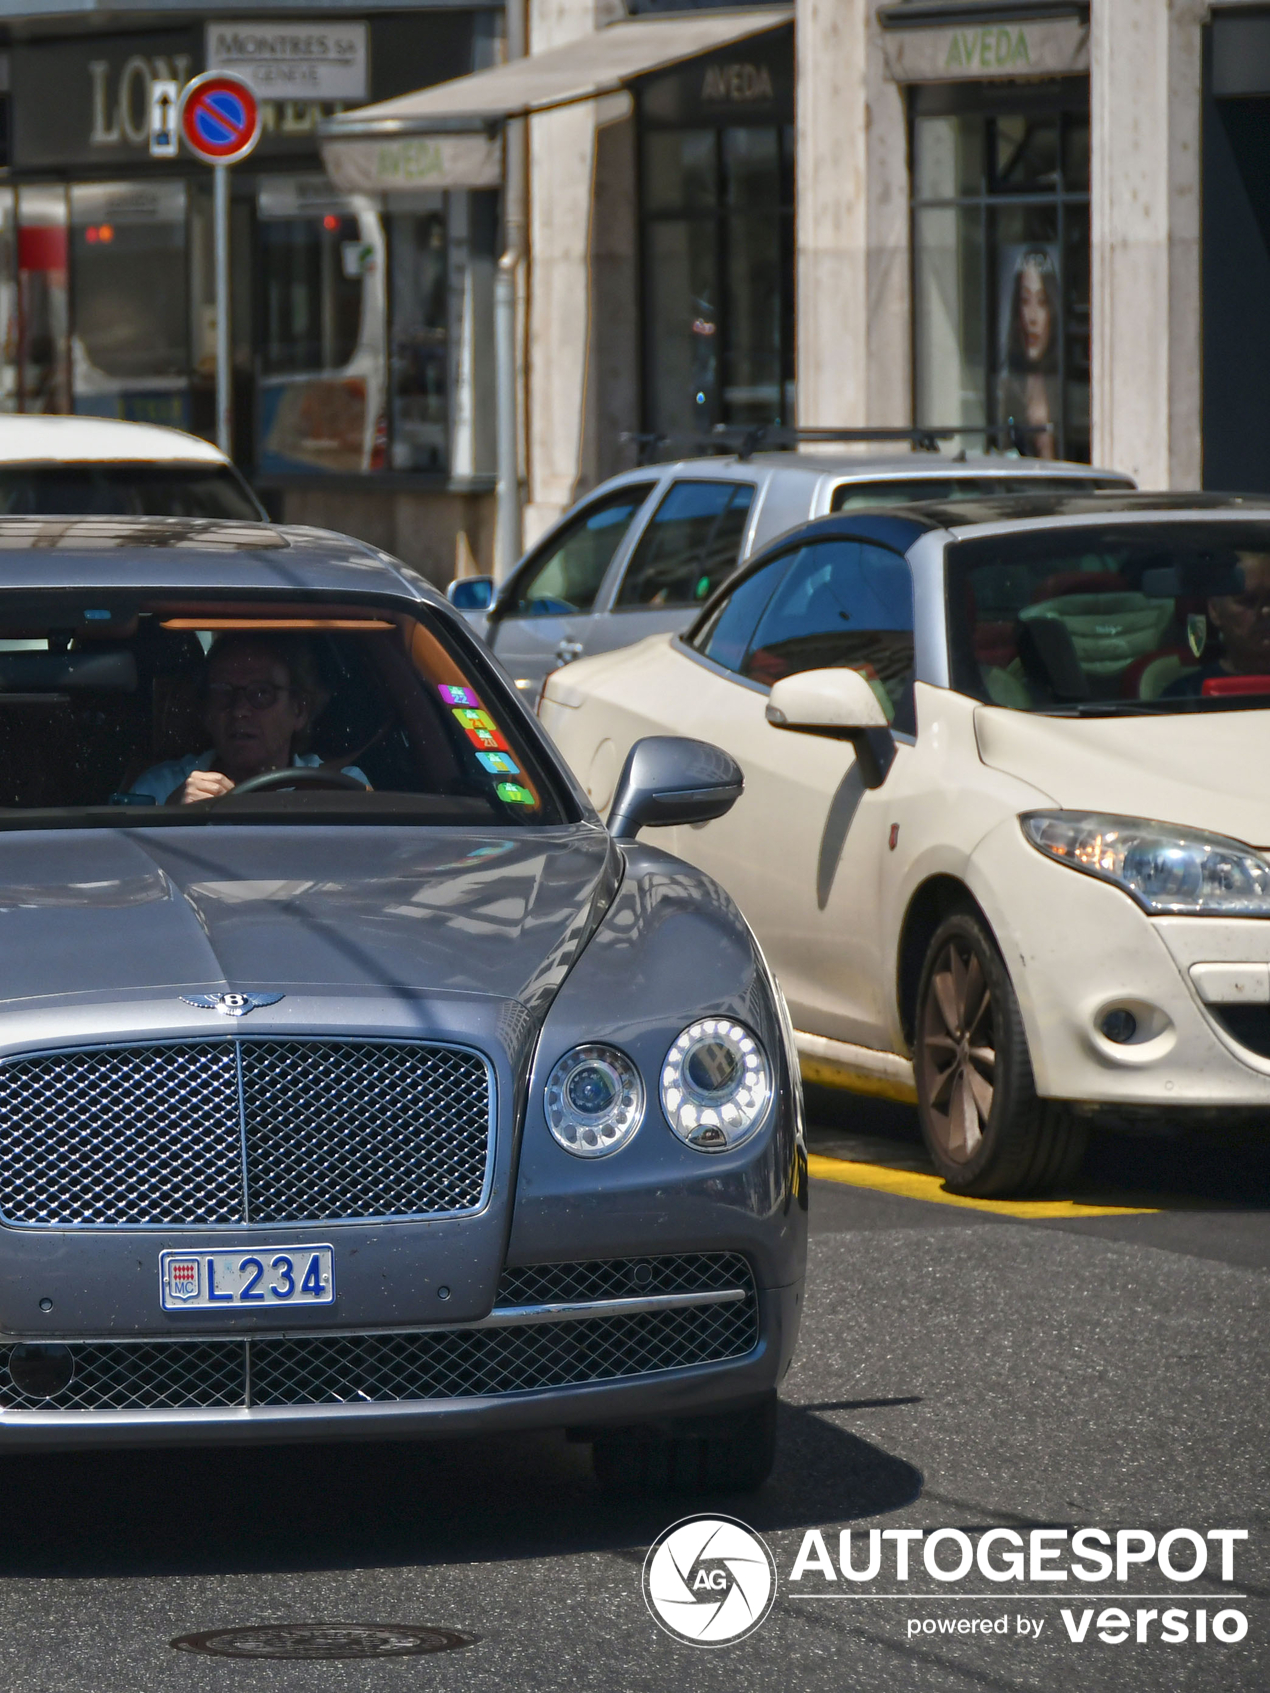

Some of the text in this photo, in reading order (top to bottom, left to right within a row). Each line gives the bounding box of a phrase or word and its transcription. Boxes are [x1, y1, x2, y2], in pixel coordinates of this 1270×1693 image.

[215, 33, 329, 54] MONTRES
[944, 26, 1030, 67] AVEDA
[701, 63, 773, 101] AVEDA
[174, 1252, 327, 1302] MC L234
